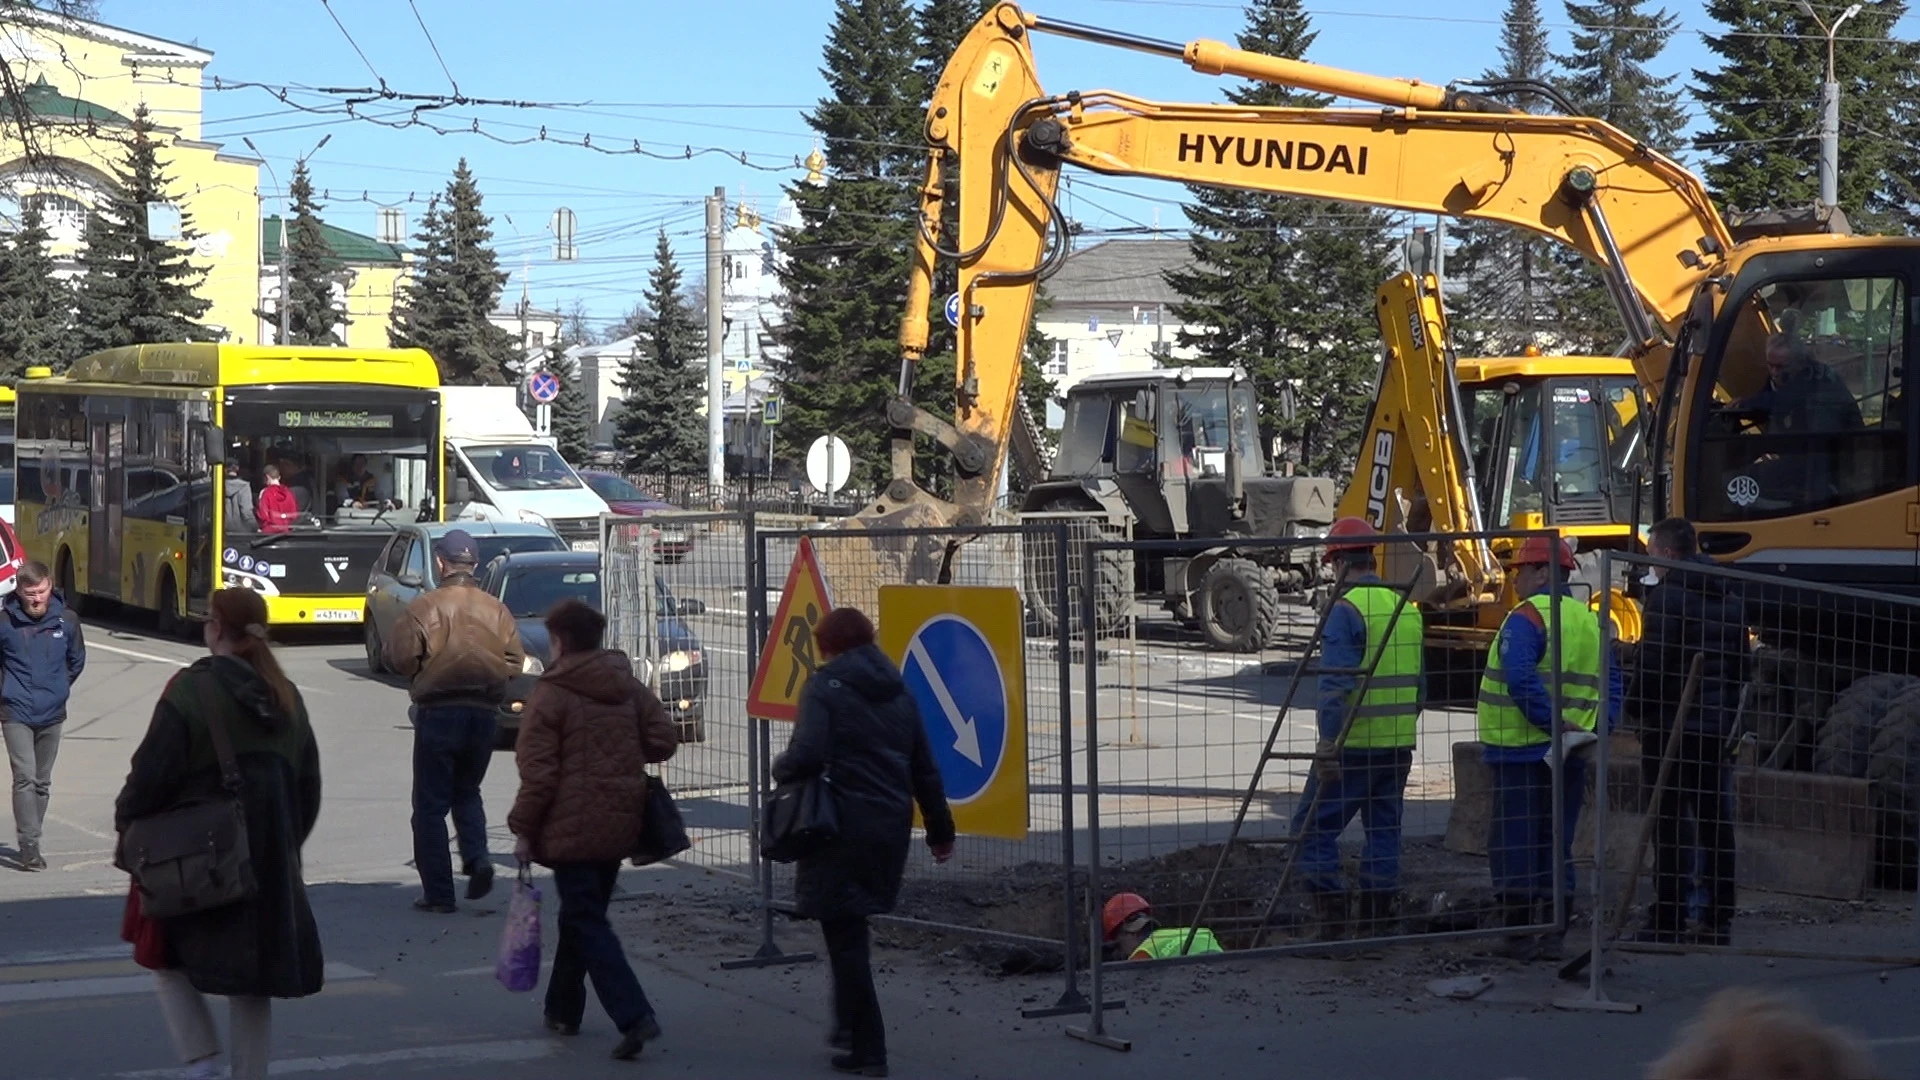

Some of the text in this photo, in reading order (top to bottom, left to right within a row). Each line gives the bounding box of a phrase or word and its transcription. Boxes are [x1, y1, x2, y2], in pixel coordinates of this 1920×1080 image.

[1178, 133, 1368, 175] HYUNDAI
[285, 411, 300, 427] 99
[1368, 432, 1393, 528] JCB
